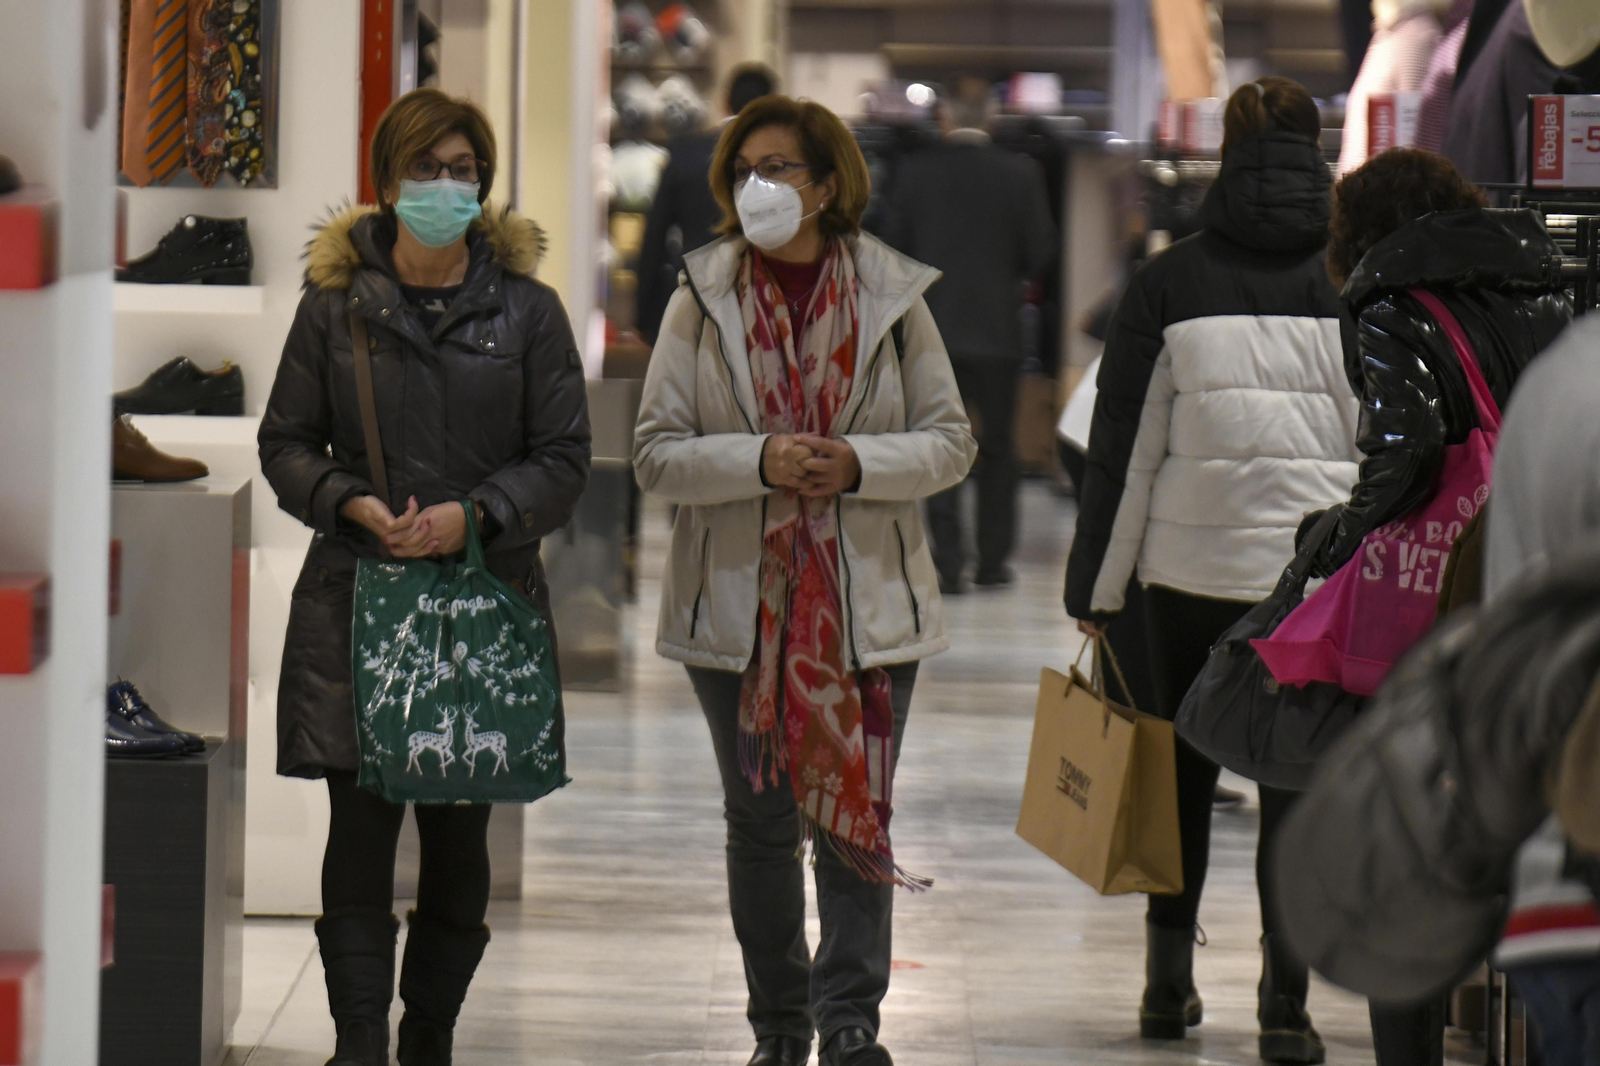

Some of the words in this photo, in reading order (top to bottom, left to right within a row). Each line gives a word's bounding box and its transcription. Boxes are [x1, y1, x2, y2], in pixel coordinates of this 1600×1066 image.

[1540, 103, 1561, 170] rebajas
[418, 593, 433, 613] El
[1060, 756, 1092, 796] TOMMY
